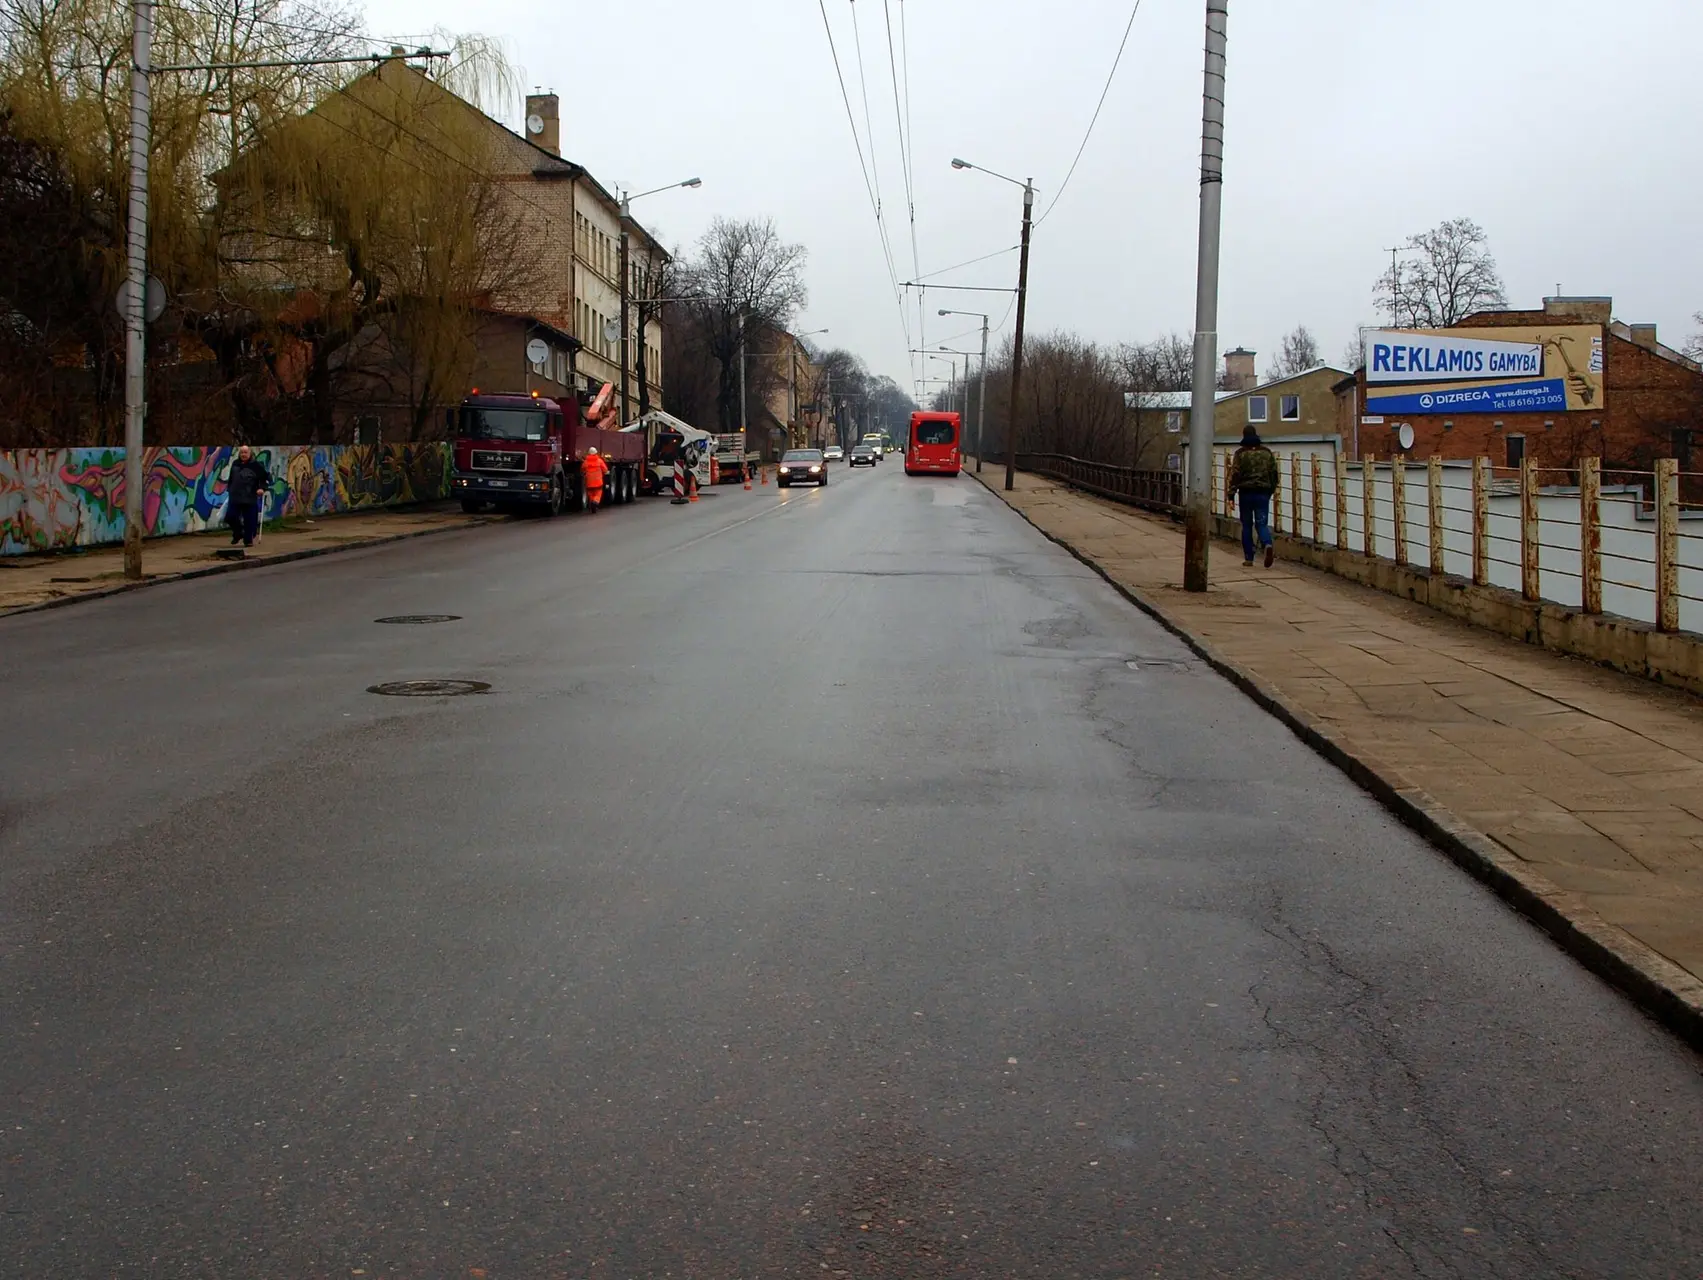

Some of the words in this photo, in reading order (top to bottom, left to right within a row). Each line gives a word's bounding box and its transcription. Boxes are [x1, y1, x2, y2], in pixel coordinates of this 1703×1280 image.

[1373, 344, 1483, 372] REKLAMOS
[1489, 352, 1537, 372] GAMYBA
[1436, 391, 1490, 404] DIZREGA
[1495, 386, 1549, 398] www.dizrega.lt
[1507, 399, 1516, 407] (8
[1516, 397, 1535, 407] 616)
[1536, 396, 1546, 405] 23
[1547, 394, 1563, 404] 005
